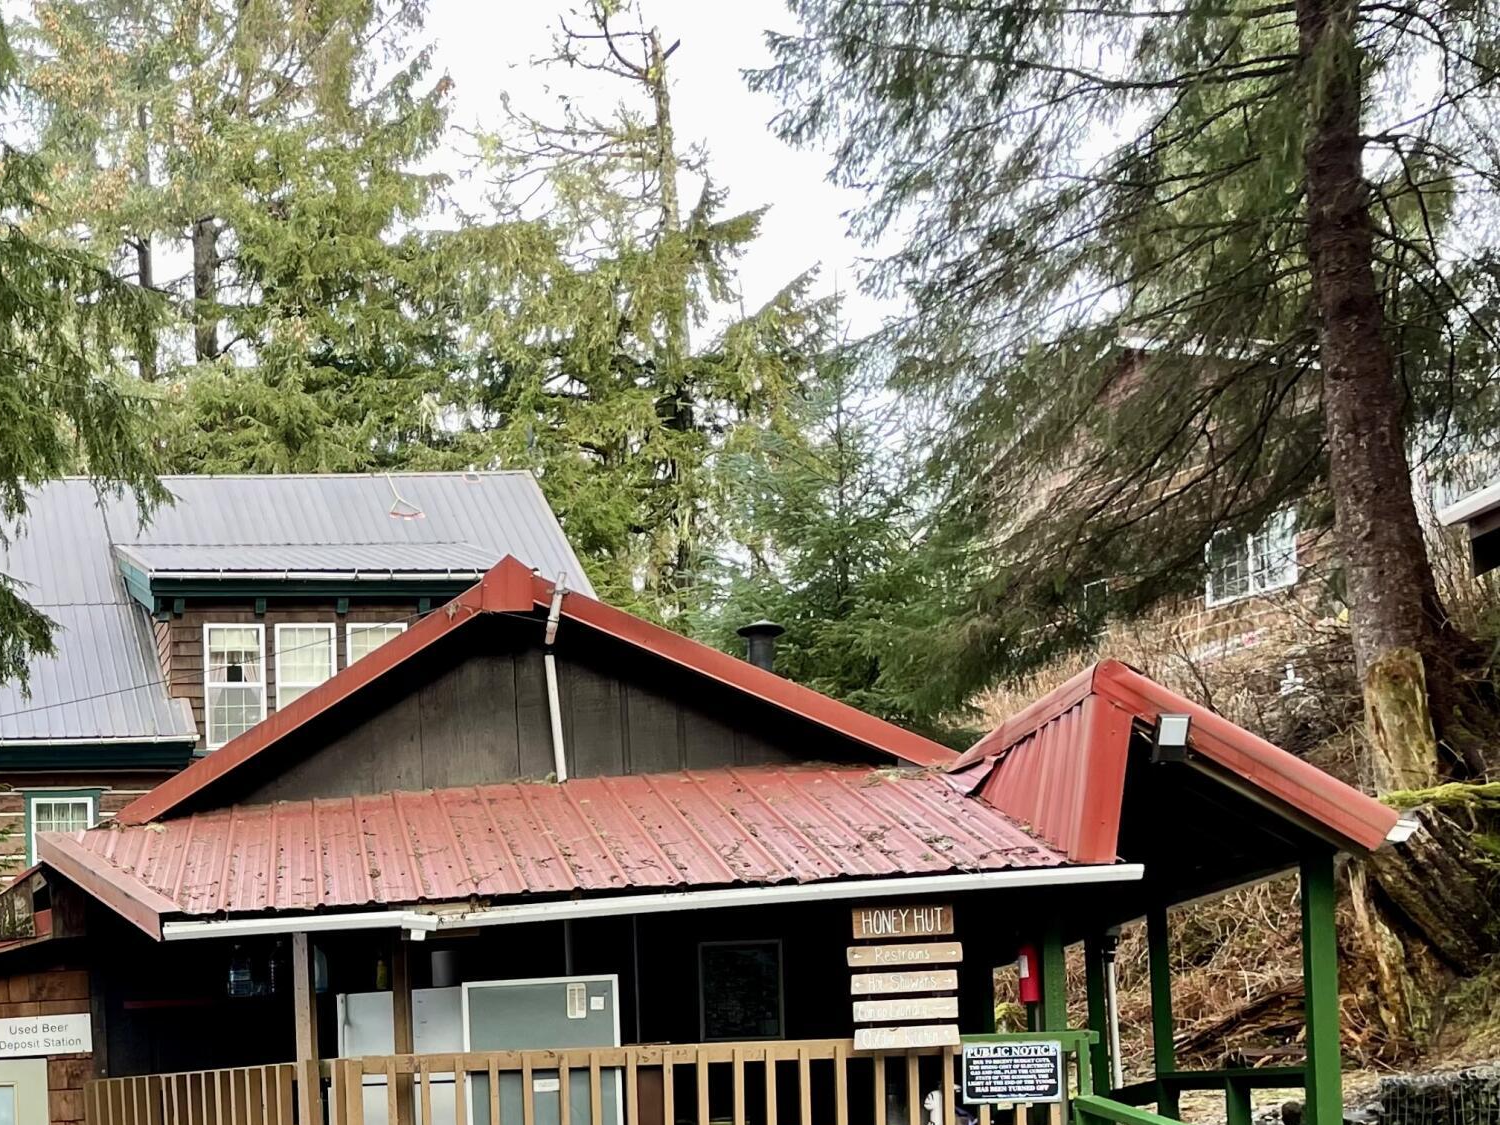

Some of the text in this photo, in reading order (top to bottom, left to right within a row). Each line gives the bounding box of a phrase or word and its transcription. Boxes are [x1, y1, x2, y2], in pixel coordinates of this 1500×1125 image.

[862, 907, 943, 934] HONEY HUT
[9, 1023, 68, 1035] Used Beer
[44, 1037, 82, 1047] Station
[967, 1046, 1056, 1058] PUBLIC NOTICE
